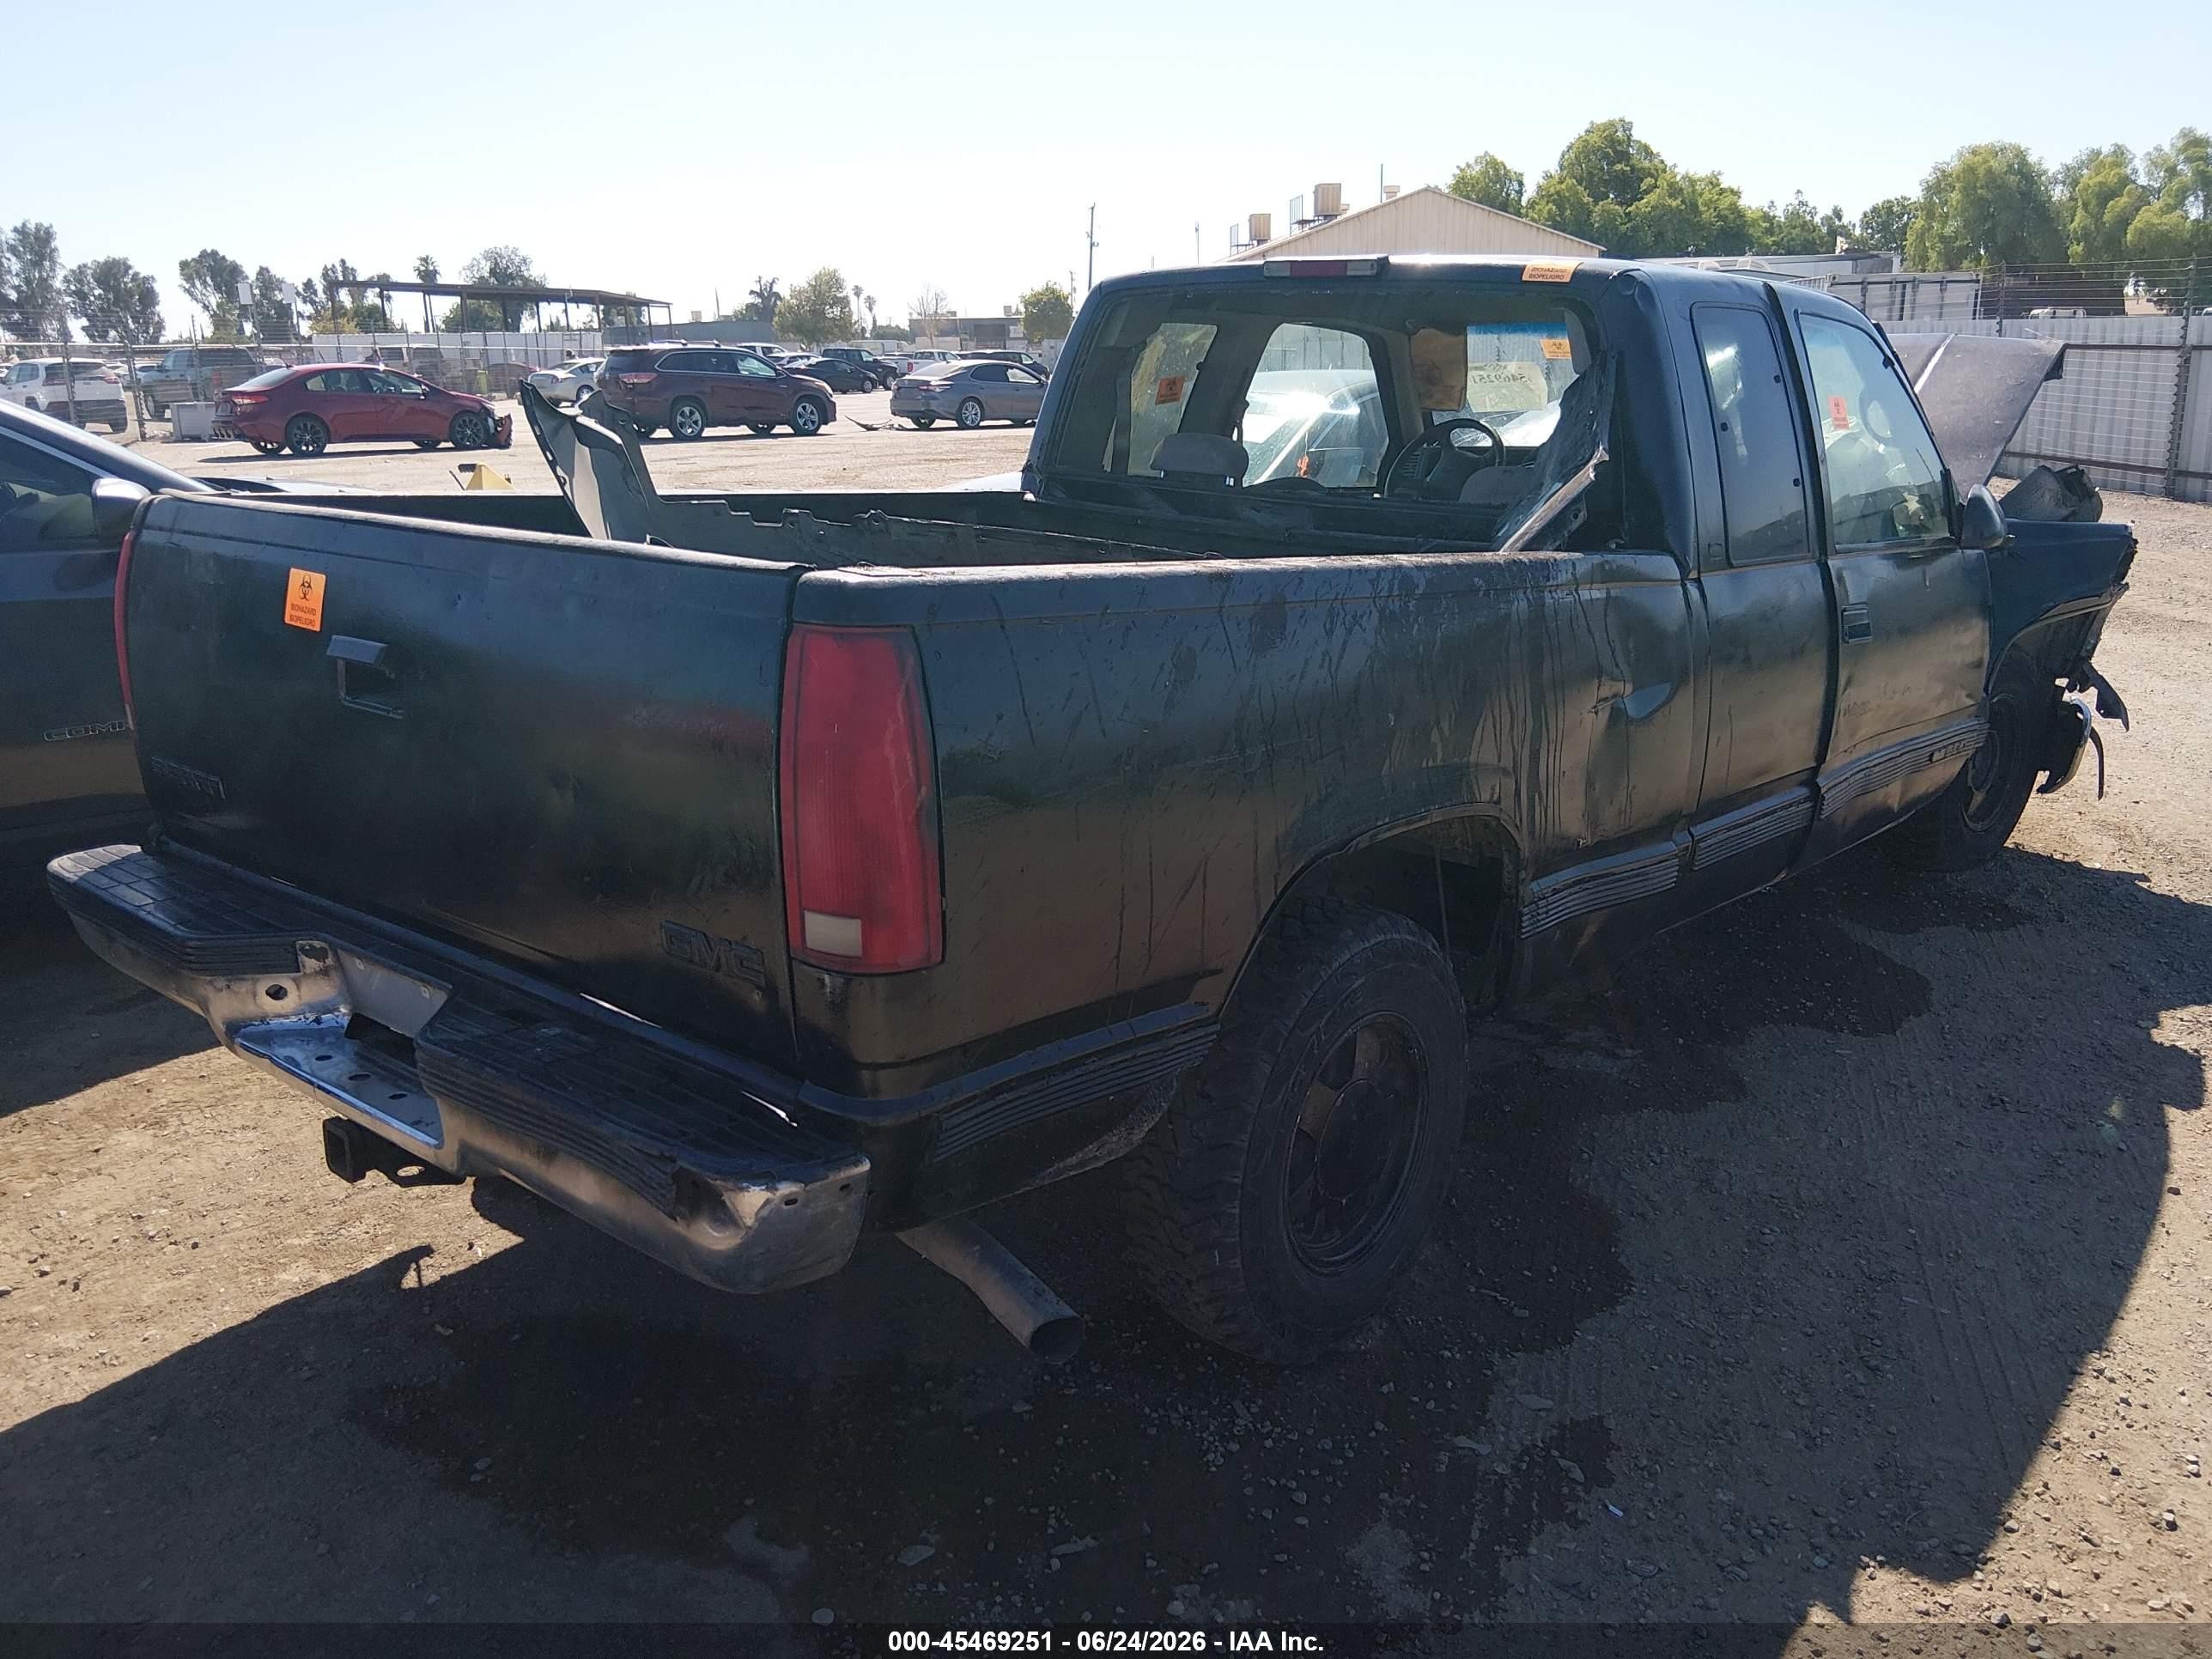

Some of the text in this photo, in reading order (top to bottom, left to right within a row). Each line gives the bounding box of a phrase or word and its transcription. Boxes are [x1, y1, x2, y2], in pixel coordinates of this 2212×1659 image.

[290, 603, 316, 616] BIOHAZARD
[289, 614, 315, 628] BIOPELIGRO
[660, 920, 767, 989] GMC
